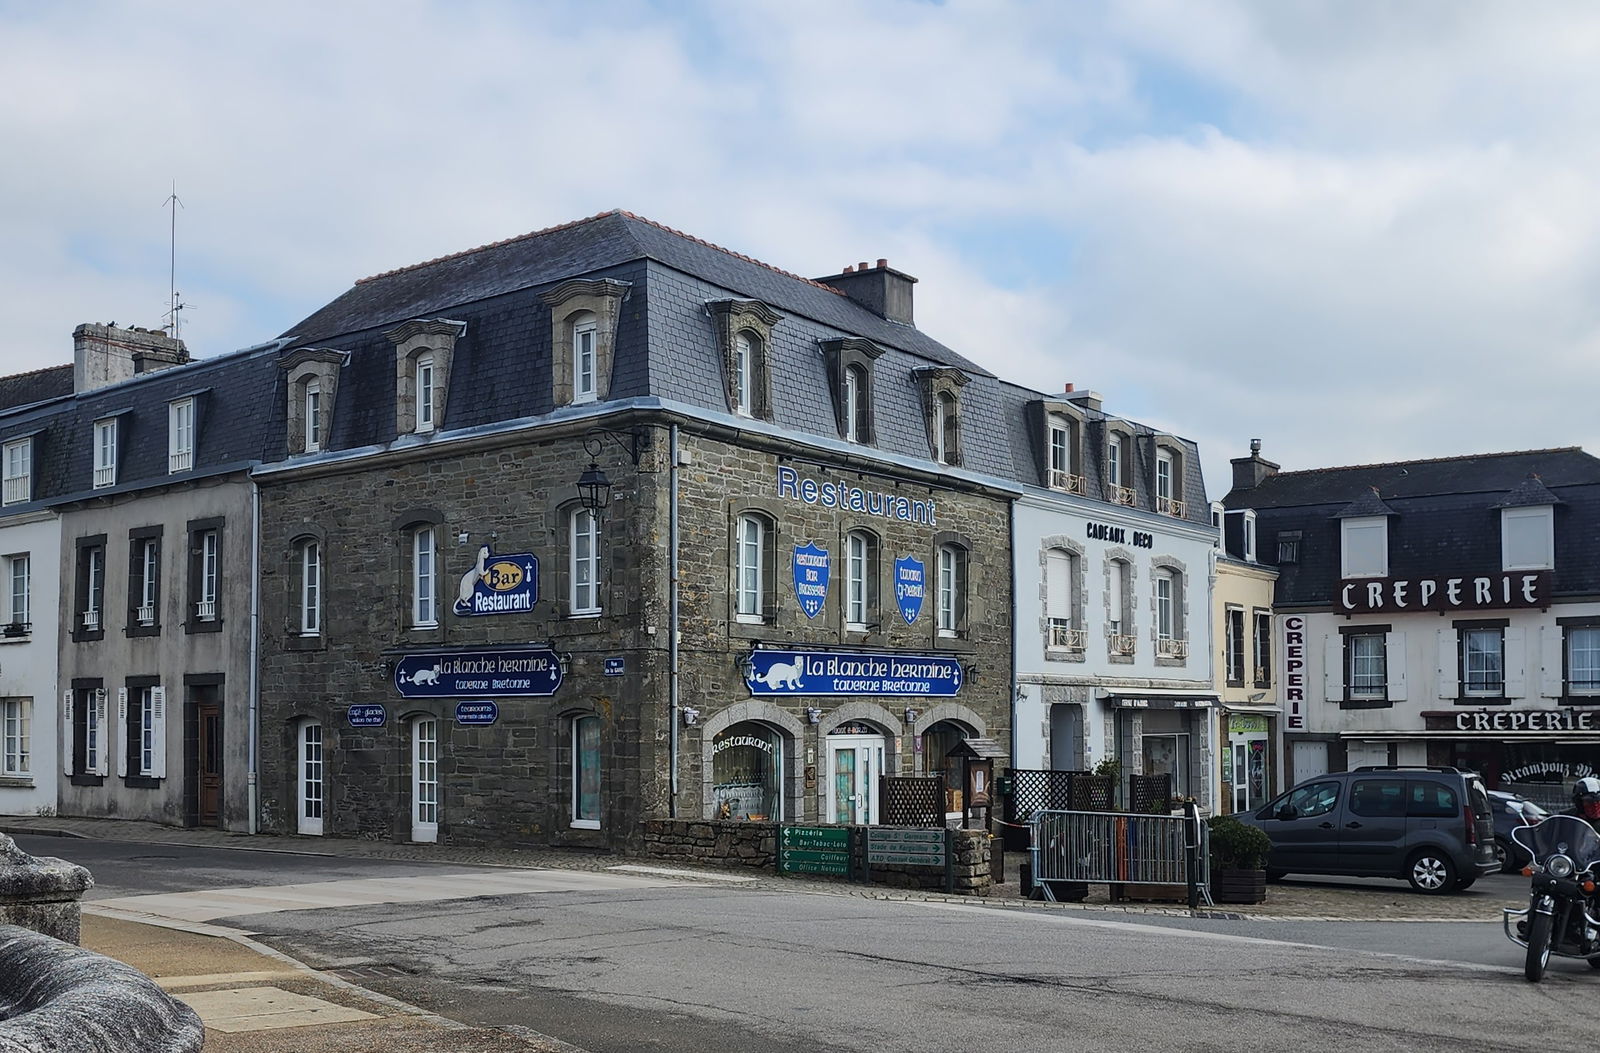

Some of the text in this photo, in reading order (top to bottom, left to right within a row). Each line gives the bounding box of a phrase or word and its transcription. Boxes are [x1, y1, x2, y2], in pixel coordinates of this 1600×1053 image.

[777, 465, 937, 526] Restaurant
[1086, 522, 1125, 544] CADEAUX
[490, 569, 519, 589] Bar
[475, 589, 531, 612] Restaurant
[1342, 575, 1539, 609] CREPERIE
[1285, 617, 1304, 729] CREPERIE
[1456, 712, 1594, 730] CREPERIE
